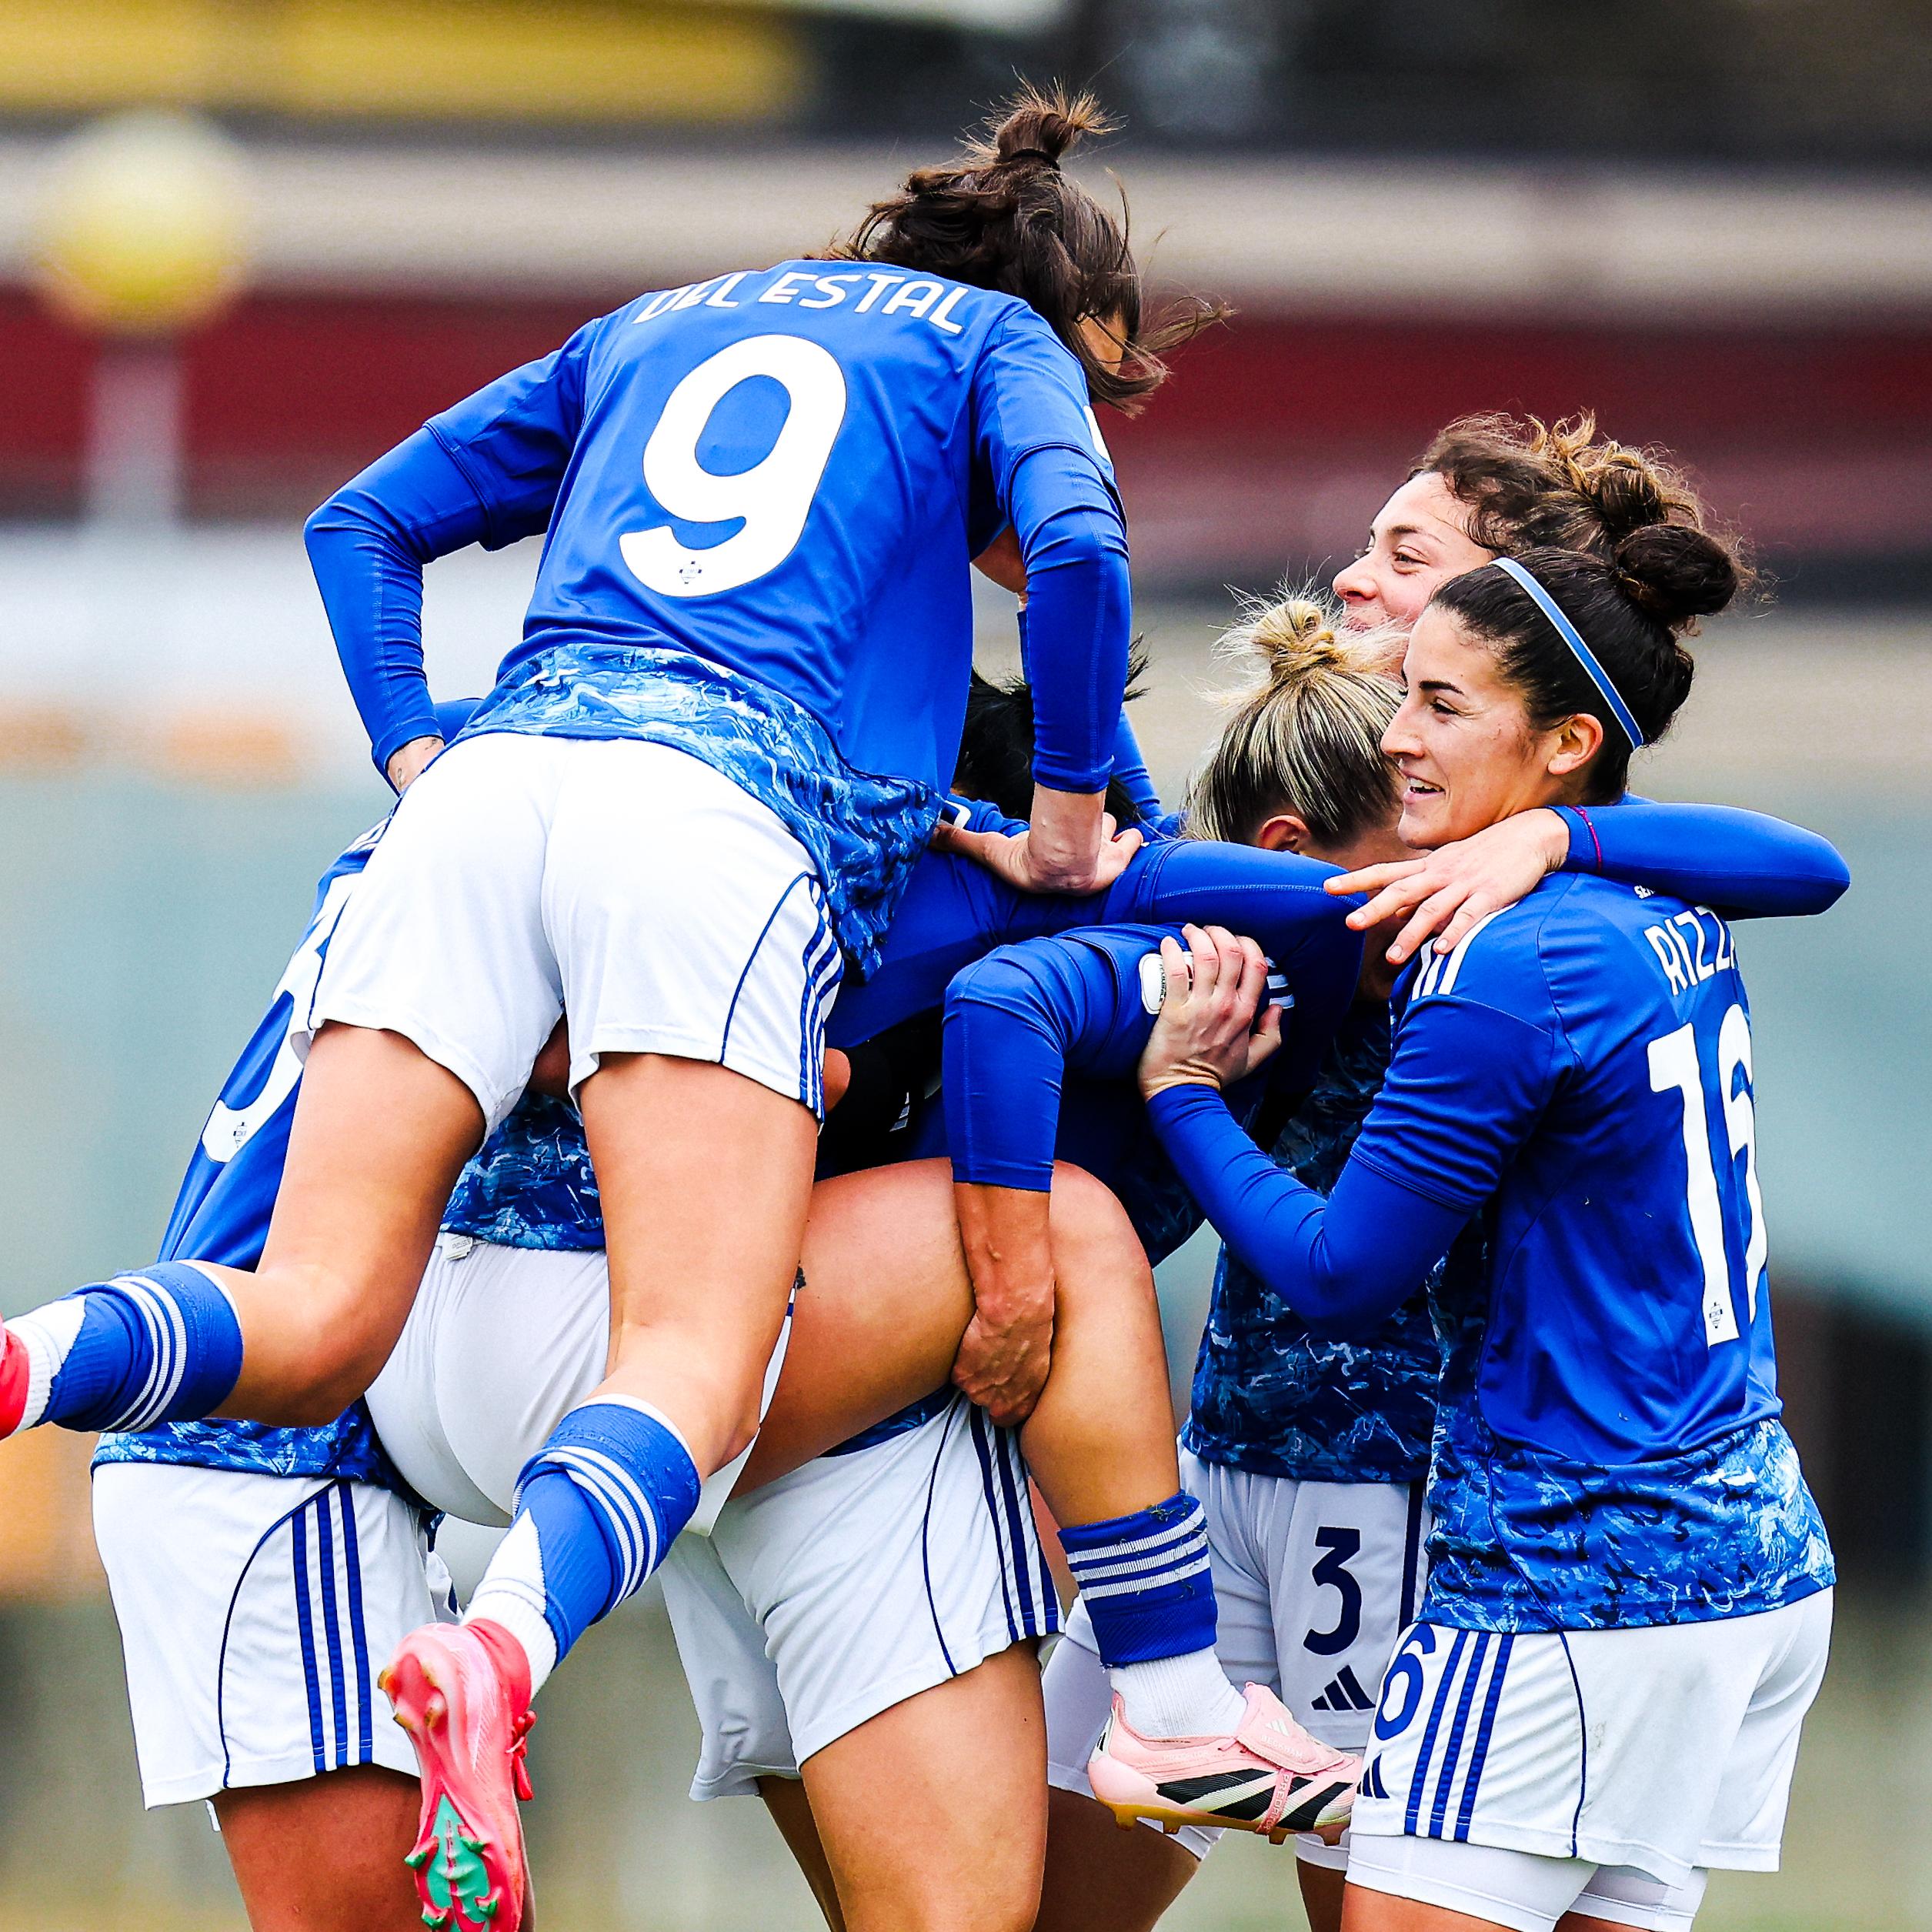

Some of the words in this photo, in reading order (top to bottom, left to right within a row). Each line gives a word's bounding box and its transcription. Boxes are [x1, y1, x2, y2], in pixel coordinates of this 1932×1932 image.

[632, 272, 740, 324] DEL
[759, 272, 969, 335] ESTAL
[619, 334, 846, 597] 9
[1643, 906, 1735, 996] RIZZ
[1303, 1527, 1362, 1656] 3
[1375, 1623, 1436, 1740] 6
